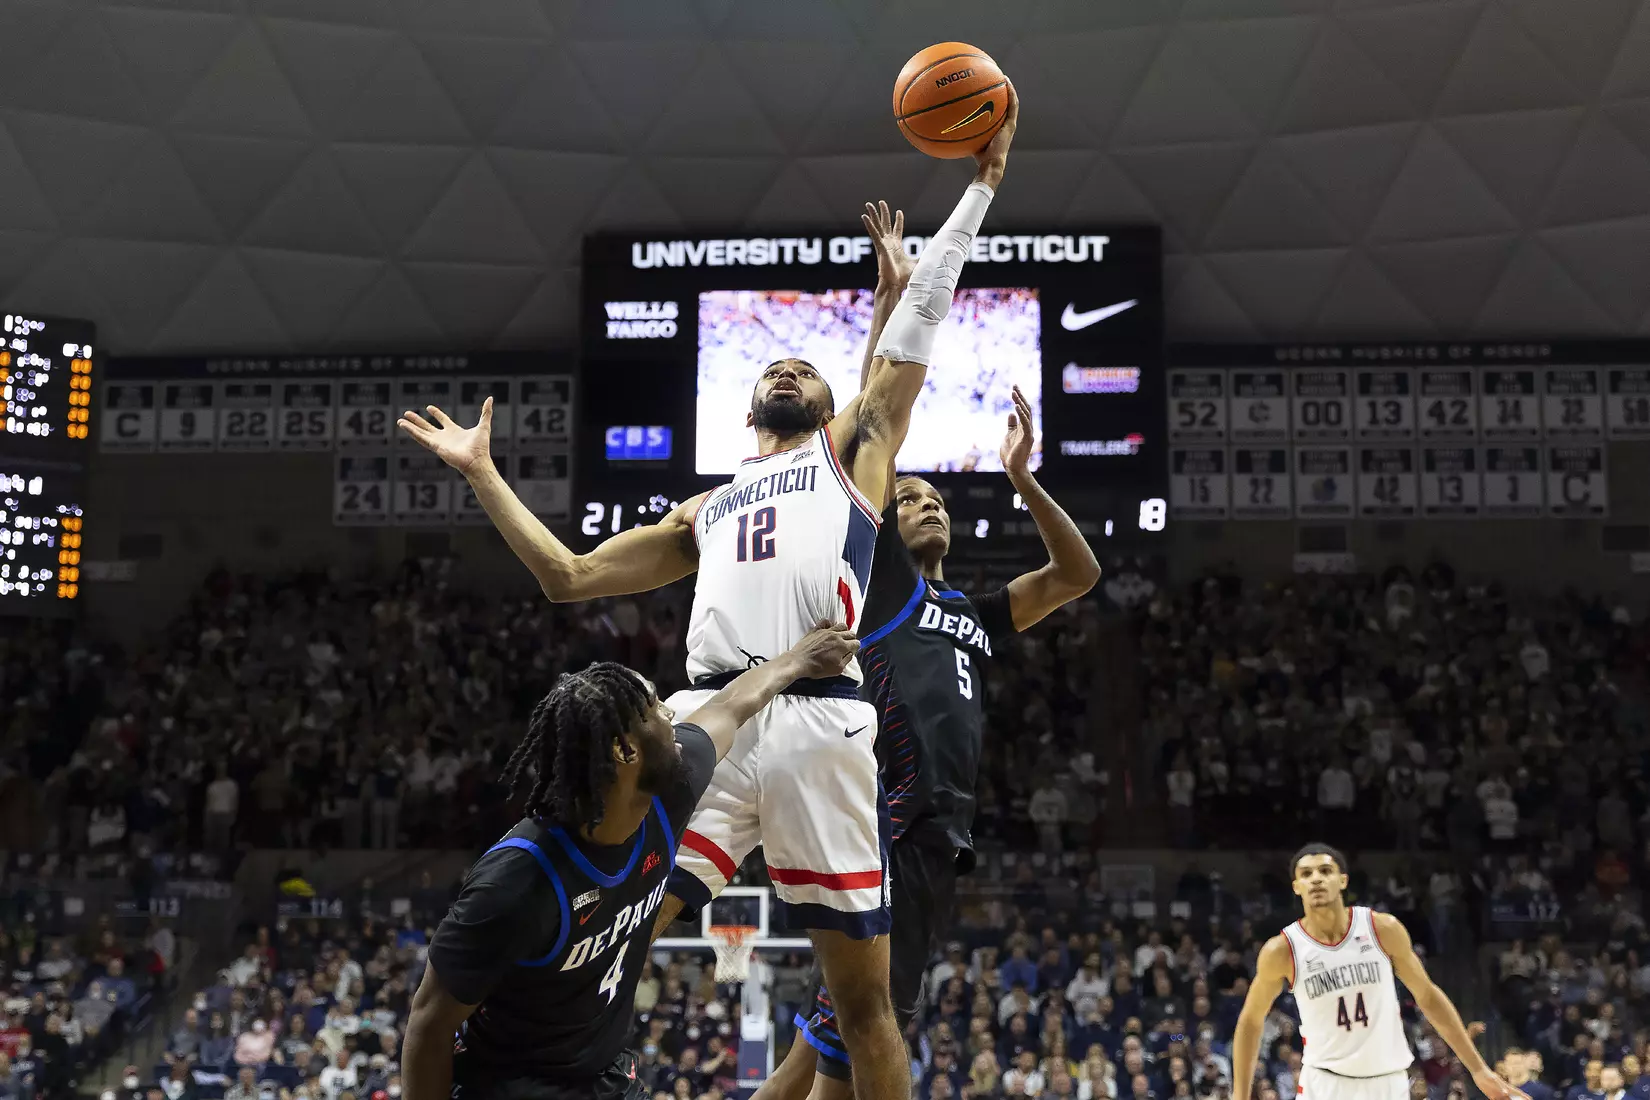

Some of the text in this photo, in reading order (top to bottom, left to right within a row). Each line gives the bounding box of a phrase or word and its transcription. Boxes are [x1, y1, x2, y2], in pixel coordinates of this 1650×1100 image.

[935, 68, 975, 88] UCONN
[632, 235, 1109, 268] UNIVERSITY OF OECTICUT
[604, 301, 679, 320] WELLS
[606, 320, 678, 339] FARGO
[116, 412, 140, 437] C
[179, 412, 196, 437] 9
[227, 411, 267, 436] 22
[285, 411, 326, 436] 25
[346, 410, 386, 435] 42
[523, 408, 566, 433] 42
[1177, 402, 1217, 427] 52
[1301, 401, 1342, 426] 00
[1367, 400, 1402, 425] 13
[1427, 399, 1469, 425] 42
[343, 484, 381, 510] 24
[407, 484, 437, 509] 13
[705, 465, 819, 534] CONNECTICUT
[1439, 476, 1463, 503] 13
[1563, 474, 1591, 504] C
[582, 502, 622, 535] 21
[737, 506, 777, 562] 12
[918, 601, 992, 656] DEPAU
[954, 647, 973, 700] 5
[149, 897, 181, 916] 113
[559, 873, 669, 972] DEPAUL
[598, 940, 631, 1006] 4
[1304, 961, 1381, 1000] CONNECTICUT
[1337, 991, 1368, 1031] 44
